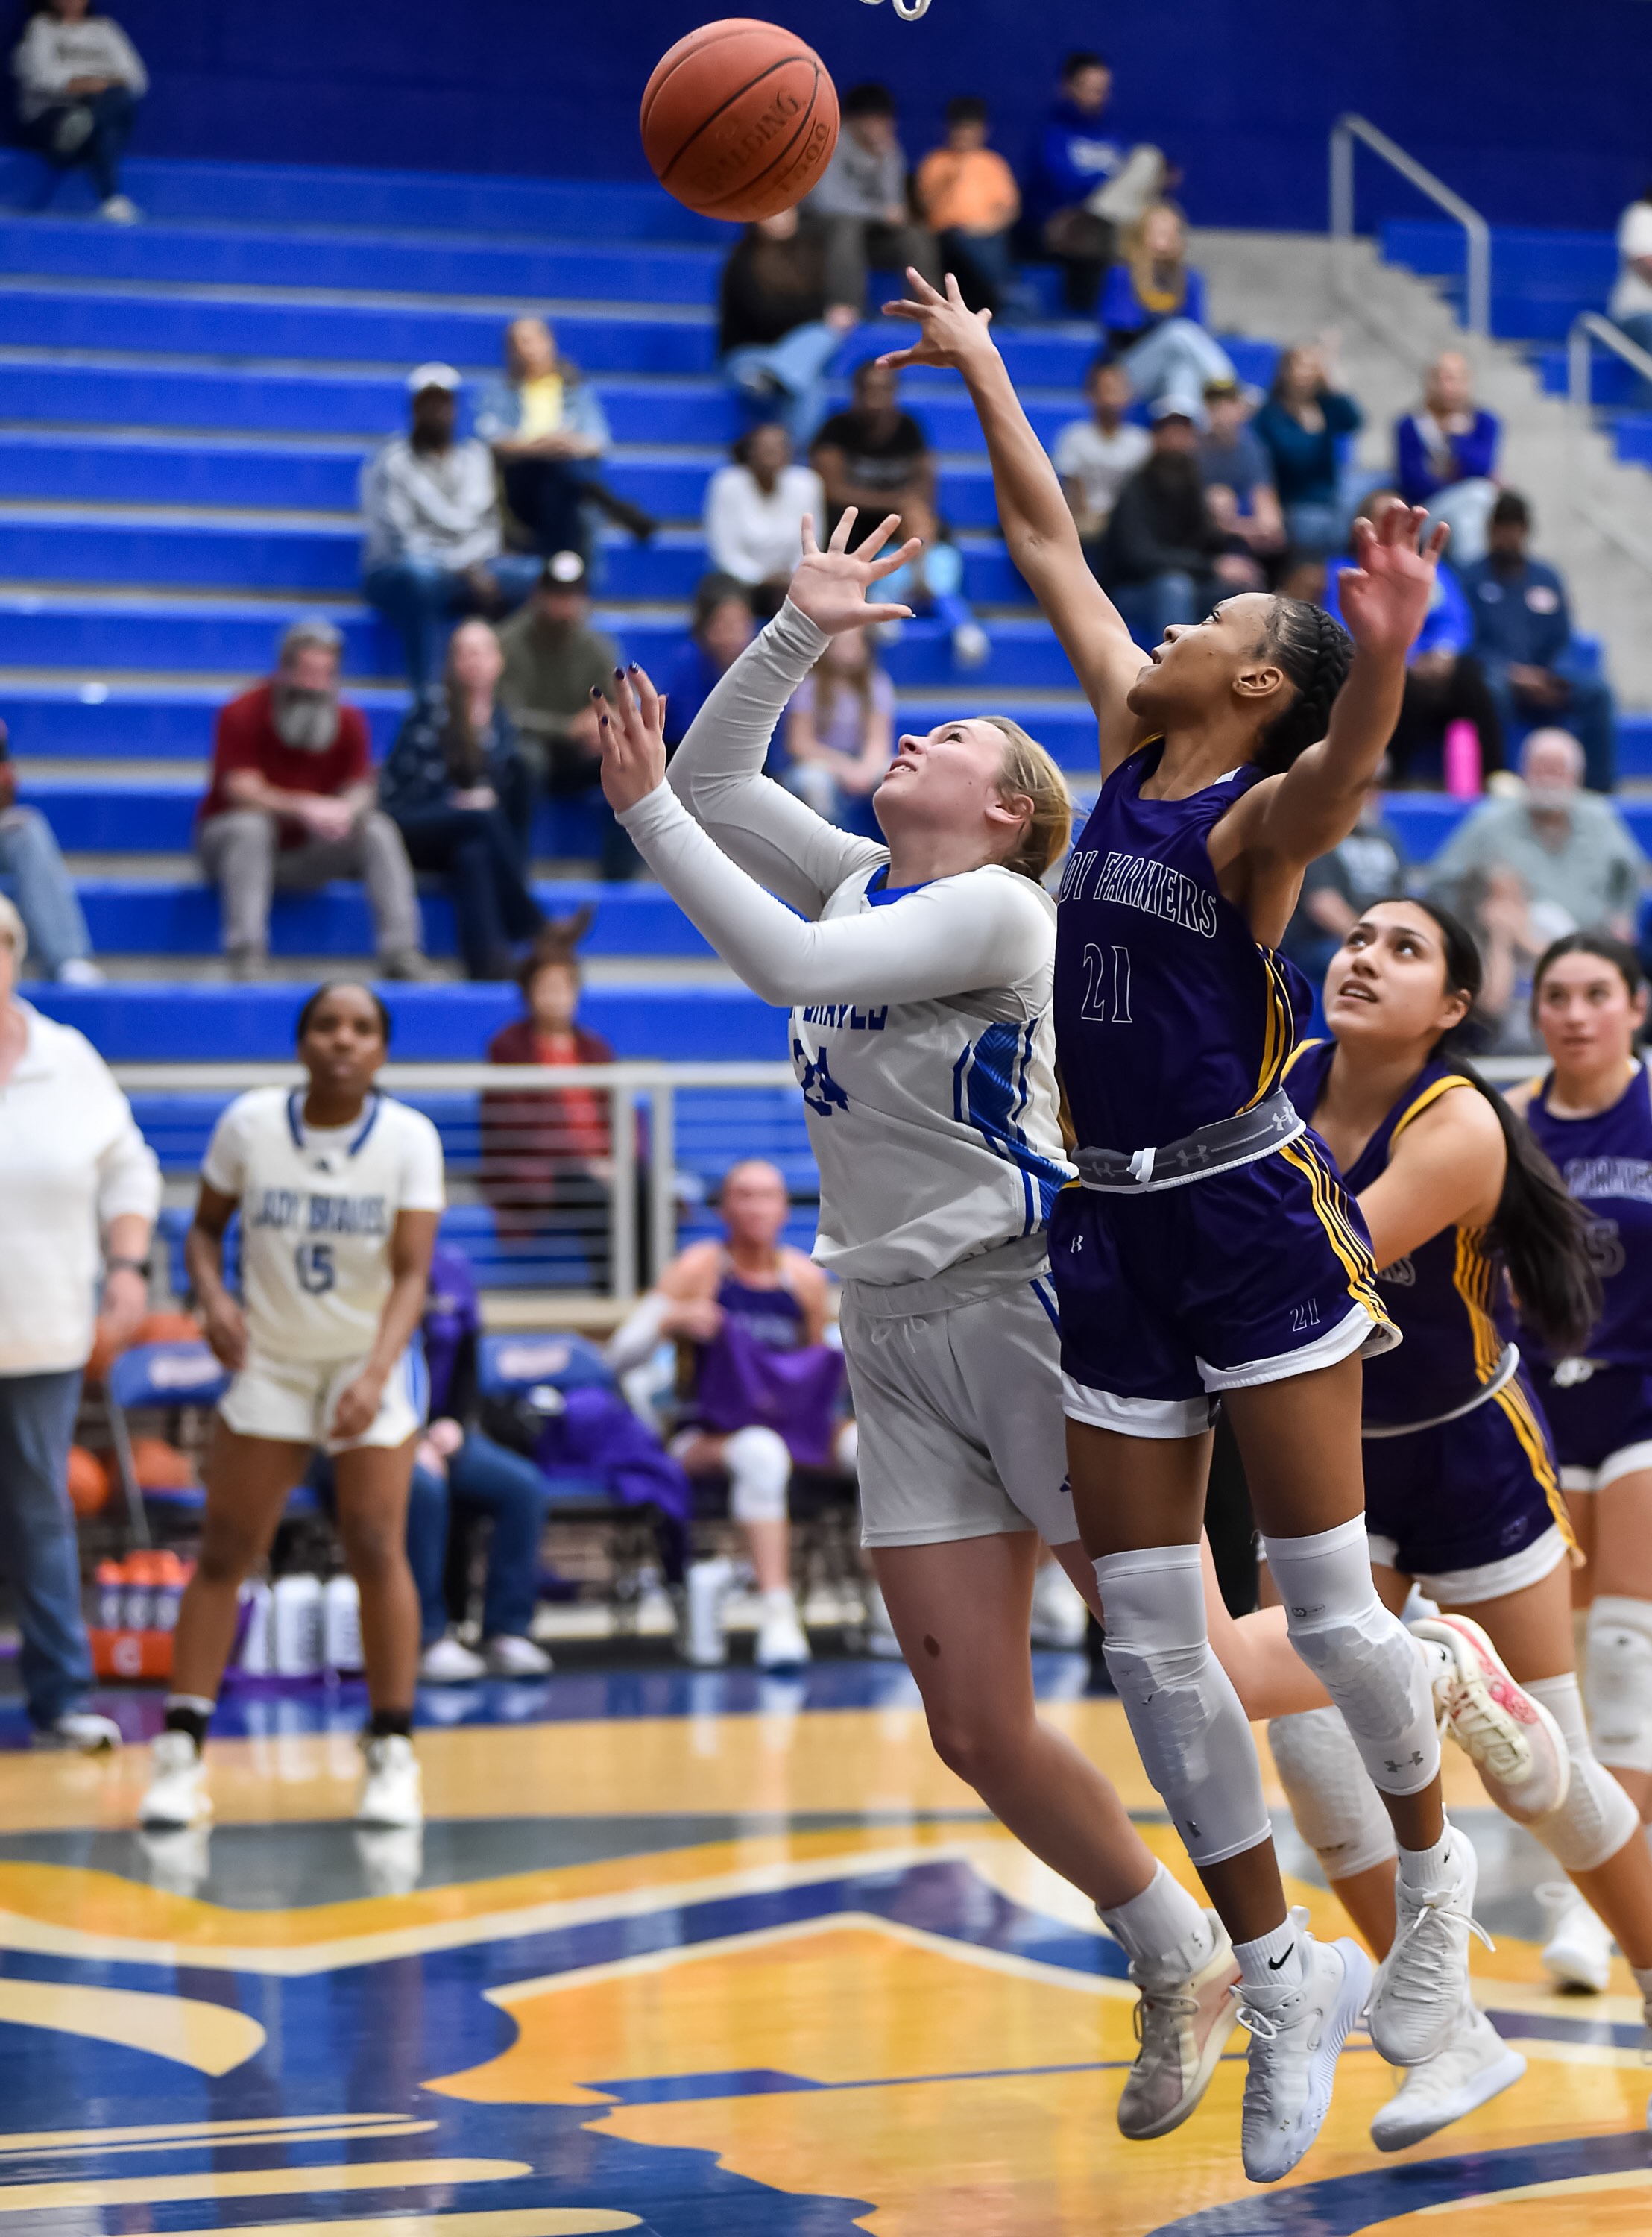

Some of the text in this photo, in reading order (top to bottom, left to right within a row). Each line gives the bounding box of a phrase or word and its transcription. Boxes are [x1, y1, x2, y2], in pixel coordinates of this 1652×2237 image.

[1093, 851, 1217, 938] FARMERS
[1081, 943, 1132, 1023] 21
[1290, 1298, 1320, 1332] 21
